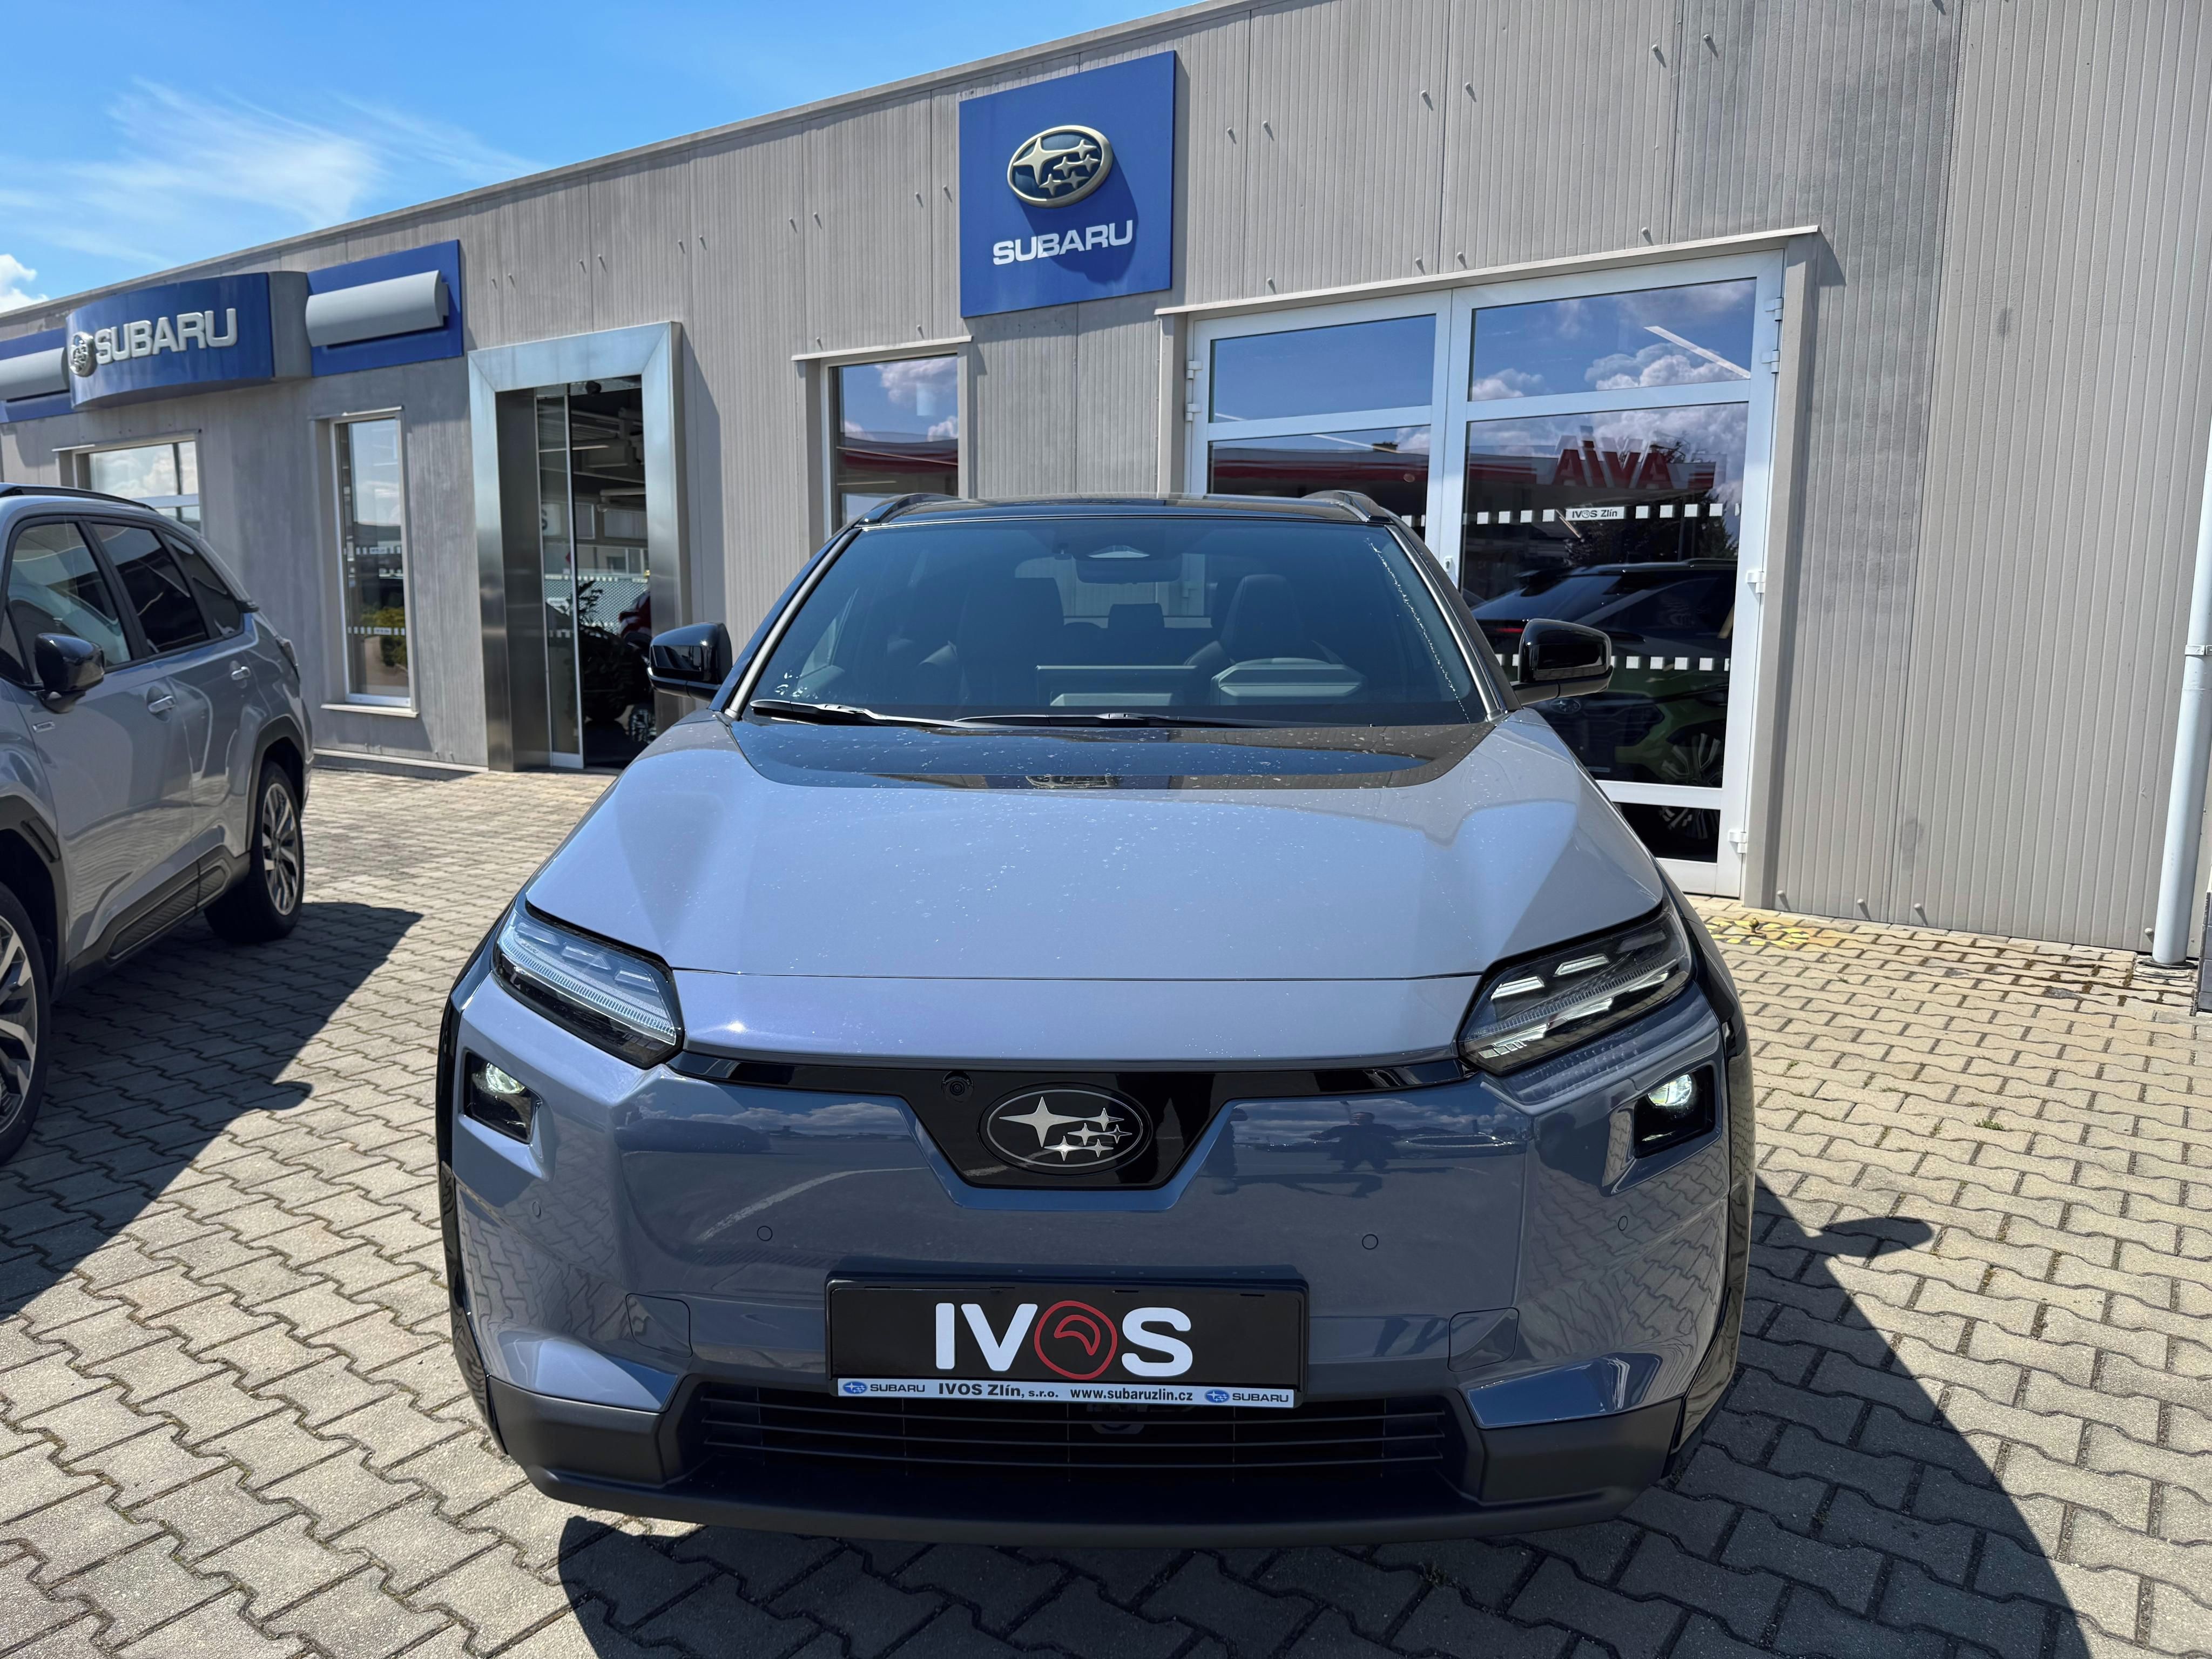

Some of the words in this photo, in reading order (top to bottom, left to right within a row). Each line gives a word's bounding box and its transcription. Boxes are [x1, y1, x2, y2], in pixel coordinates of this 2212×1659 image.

[993, 220, 1132, 265] SUBARU
[95, 308, 238, 365] SUBARU
[1572, 510, 1597, 518] IVOS
[1601, 509, 1617, 517] Zlín
[936, 1300, 1193, 1380] IVOS
[870, 1384, 926, 1393] SUBARU
[939, 1382, 982, 1396] IVOS
[987, 1384, 1024, 1399] Zlín,
[1028, 1390, 1058, 1398] s.r.o.
[1070, 1387, 1193, 1401] www.subaruzlin.cz
[1232, 1393, 1289, 1402] SUBARU
